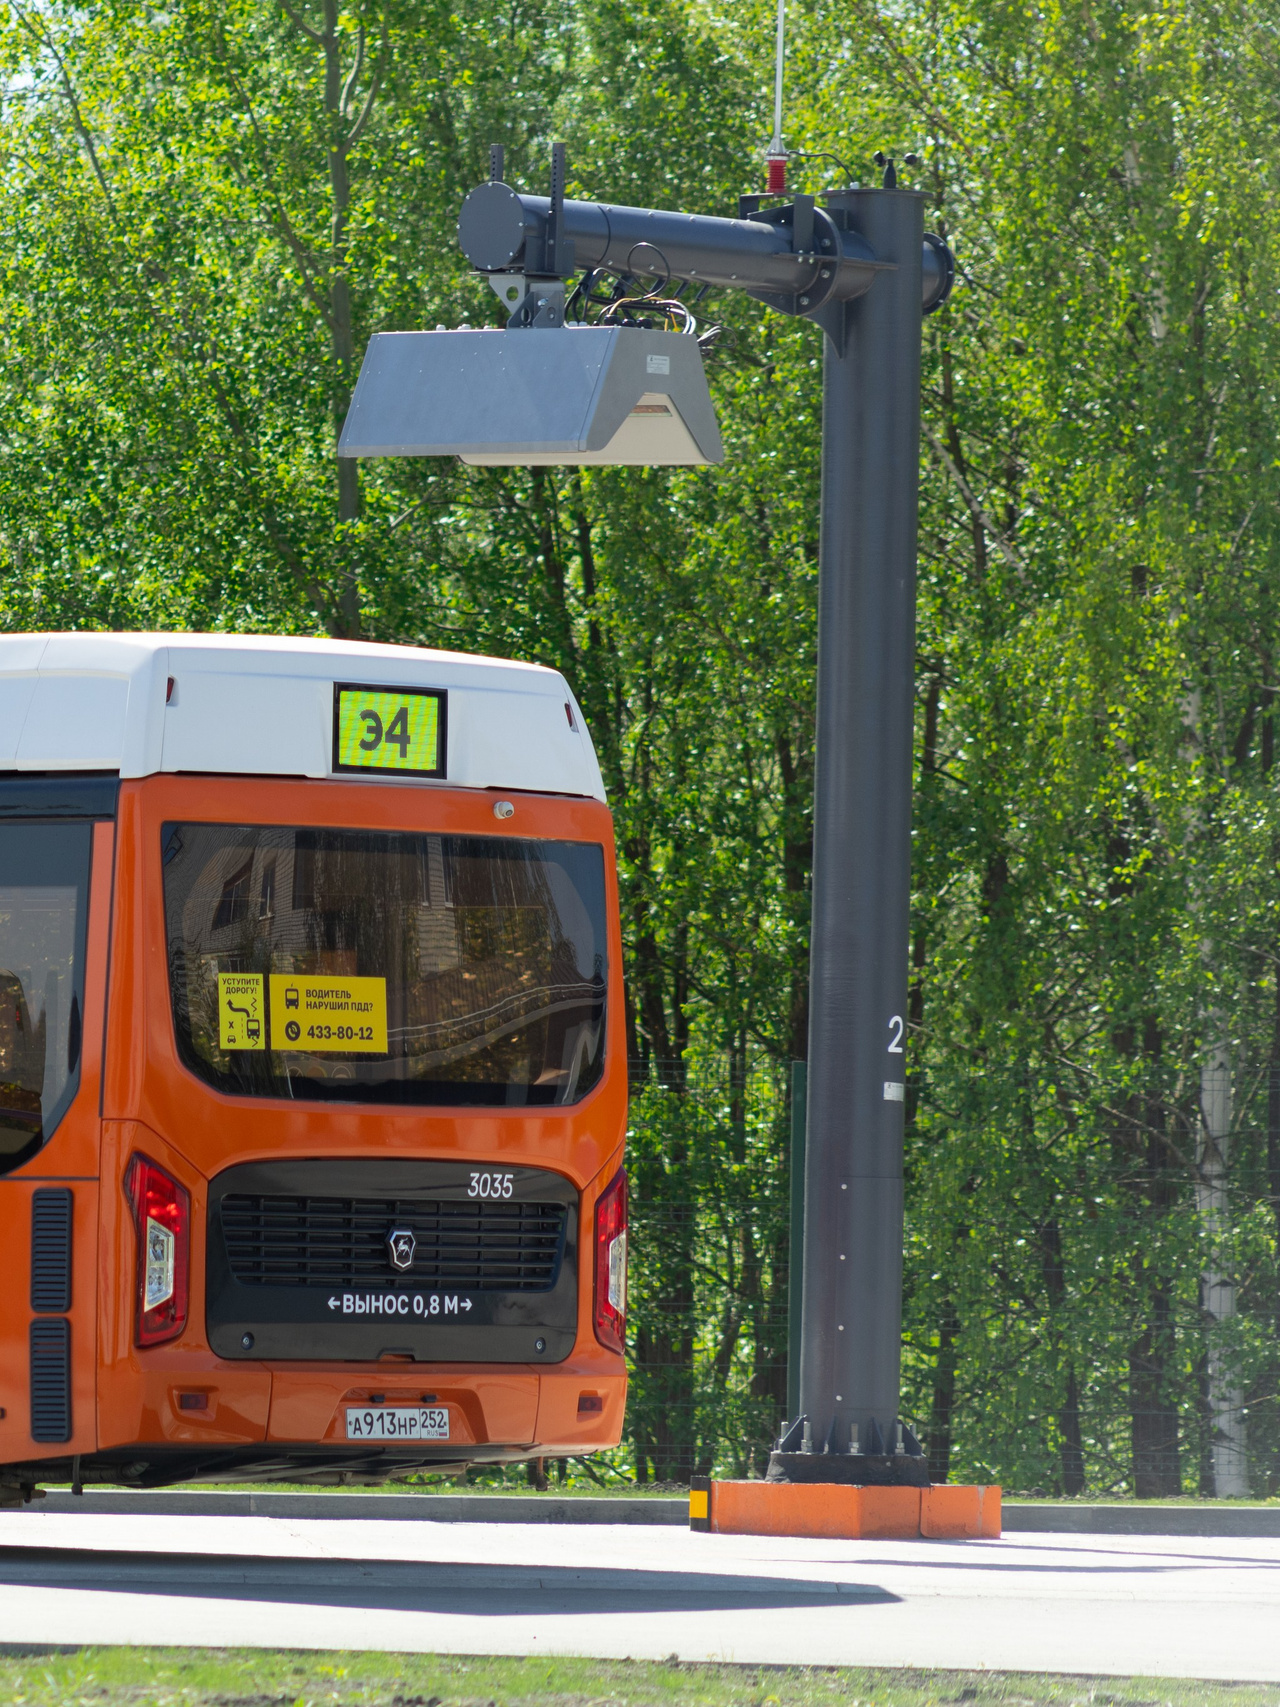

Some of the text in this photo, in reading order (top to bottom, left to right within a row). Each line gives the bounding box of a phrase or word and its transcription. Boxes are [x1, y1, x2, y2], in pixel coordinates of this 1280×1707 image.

[358, 706, 411, 759] Э4
[221, 977, 260, 986] УСТУПИТЕ
[225, 986, 257, 995] ДОРОГУ!
[305, 988, 352, 999] ВОДИТЕЛЬ
[305, 1000, 374, 1012] НАРУШИЛ ПДД?
[306, 1024, 374, 1041] 433-80-12
[887, 1015, 904, 1053] 2
[467, 1172, 514, 1199] 3035
[342, 1293, 459, 1318] ВЫНОС 0,8 М
[352, 1410, 445, 1436] А913НР 252
[426, 1429, 439, 1437] RUS
